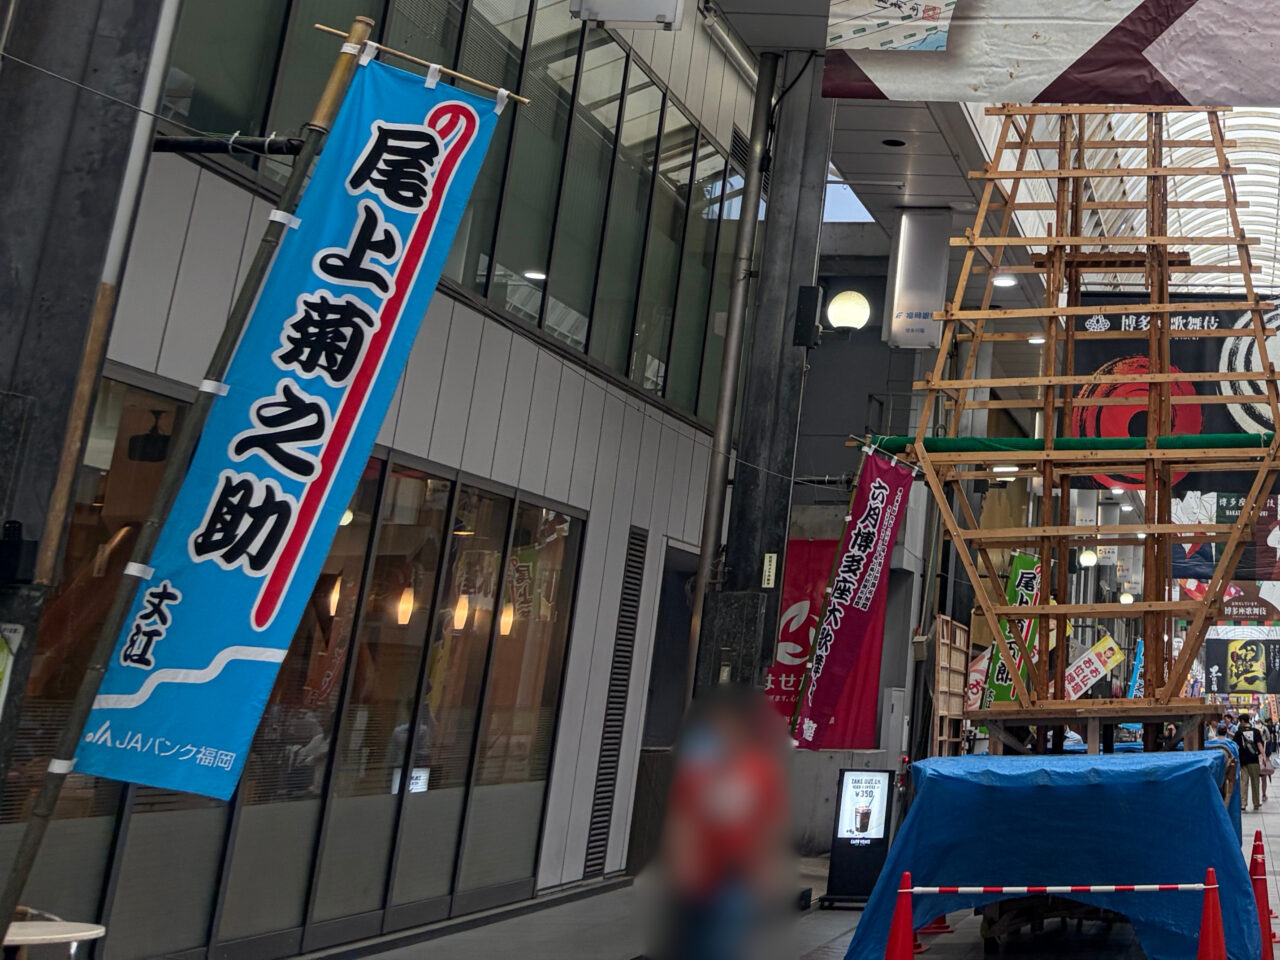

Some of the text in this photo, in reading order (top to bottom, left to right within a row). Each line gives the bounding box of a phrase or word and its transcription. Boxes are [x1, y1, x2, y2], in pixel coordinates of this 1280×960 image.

[1121, 315, 1220, 331] 博多歌舞伎
[192, 124, 441, 568] 尾上菊之助
[116, 731, 236, 771] JAバンク福岡
